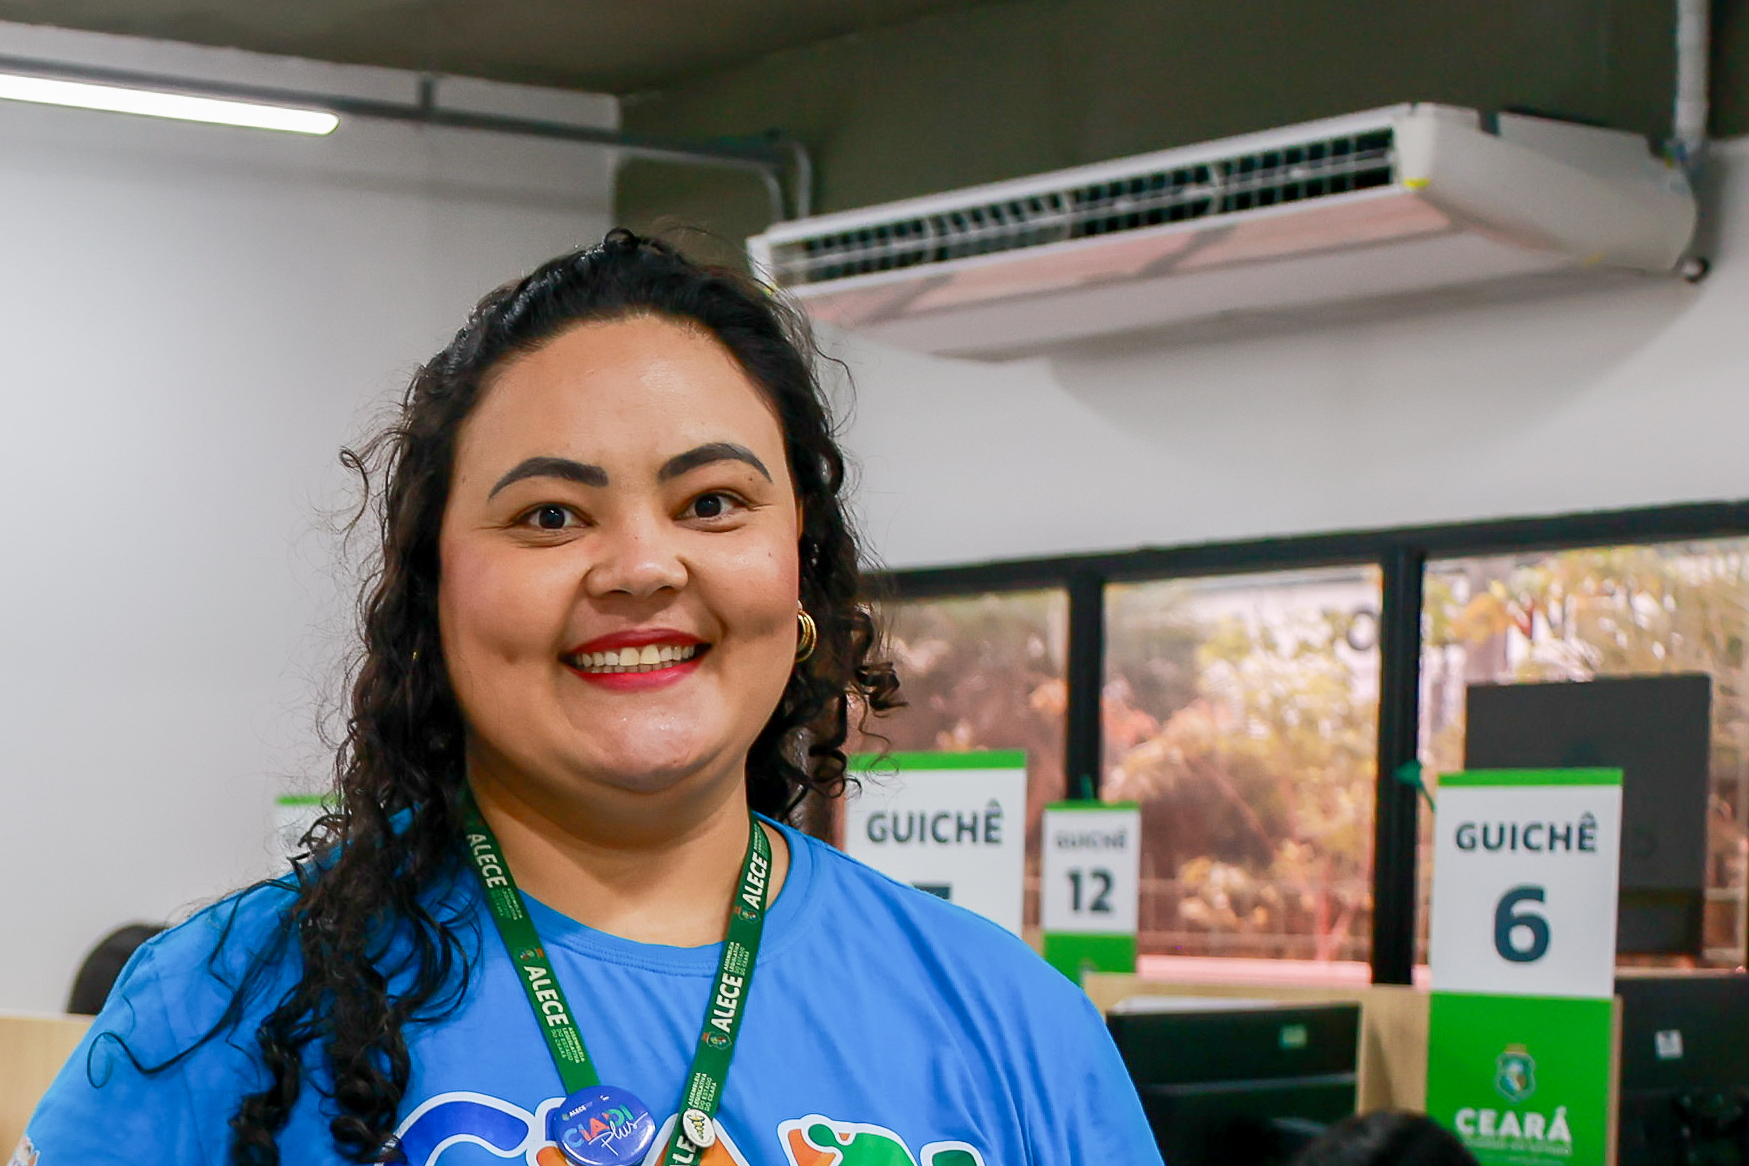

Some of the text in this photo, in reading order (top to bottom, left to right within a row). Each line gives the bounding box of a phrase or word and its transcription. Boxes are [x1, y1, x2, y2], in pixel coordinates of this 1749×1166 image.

[866, 798, 1003, 844] GUICHÊ
[1454, 811, 1598, 852] GUICHÊ
[466, 833, 509, 889] ALECE
[742, 852, 768, 910] ALECE
[1067, 867, 1114, 913] 12
[1493, 884, 1551, 963] 6
[524, 965, 570, 1027] ALECE
[710, 972, 744, 1034] ALECE
[563, 1104, 635, 1148] CIADI
[1455, 1105, 1573, 1142] CEARÁ
